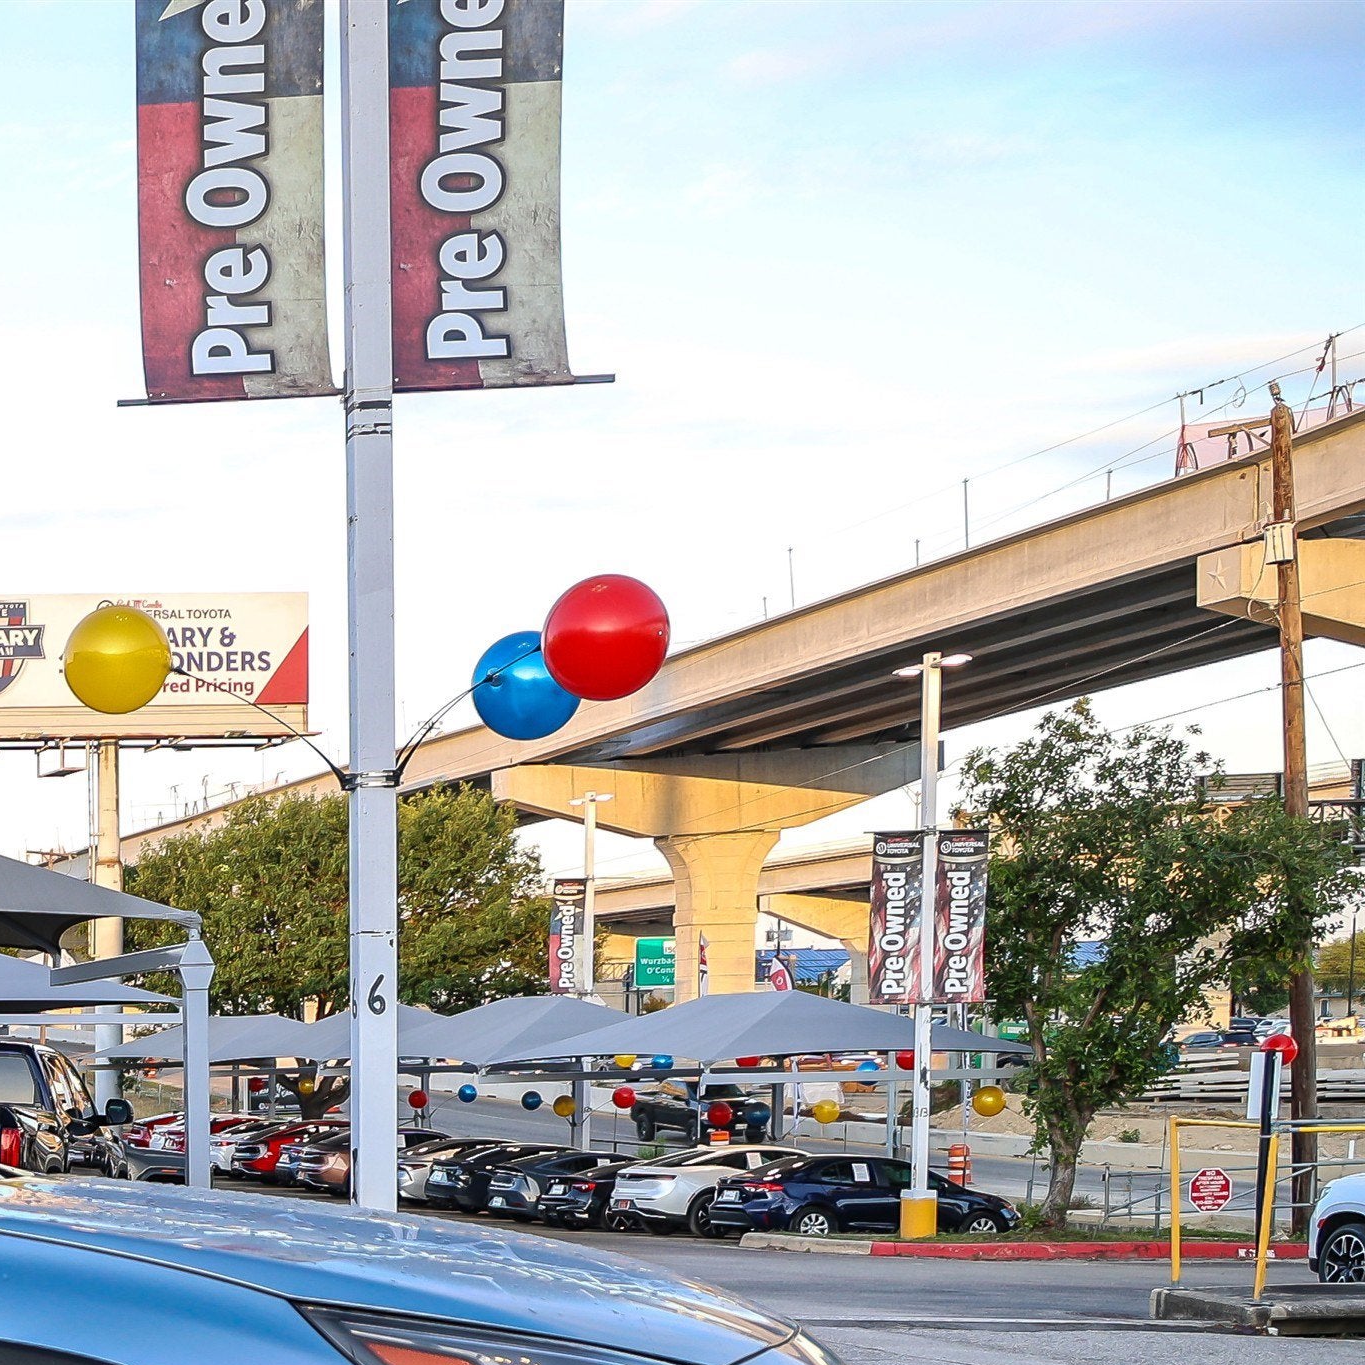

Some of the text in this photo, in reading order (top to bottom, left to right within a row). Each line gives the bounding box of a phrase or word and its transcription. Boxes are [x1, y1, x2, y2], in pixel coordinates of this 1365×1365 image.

[185, 0, 272, 375] Pre Owne
[420, 0, 509, 360] Pre Owne
[187, 609, 231, 619] TOYOTA
[219, 626, 236, 647] &
[171, 651, 271, 672] ONDERS
[195, 678, 254, 696] Pricing
[880, 872, 907, 951] Owned
[943, 871, 971, 951] Owned
[557, 905, 575, 960] Owned
[558, 961, 575, 988] Pre
[881, 956, 905, 994] Pre
[944, 956, 968, 993] Pre
[368, 974, 386, 1015] 6
